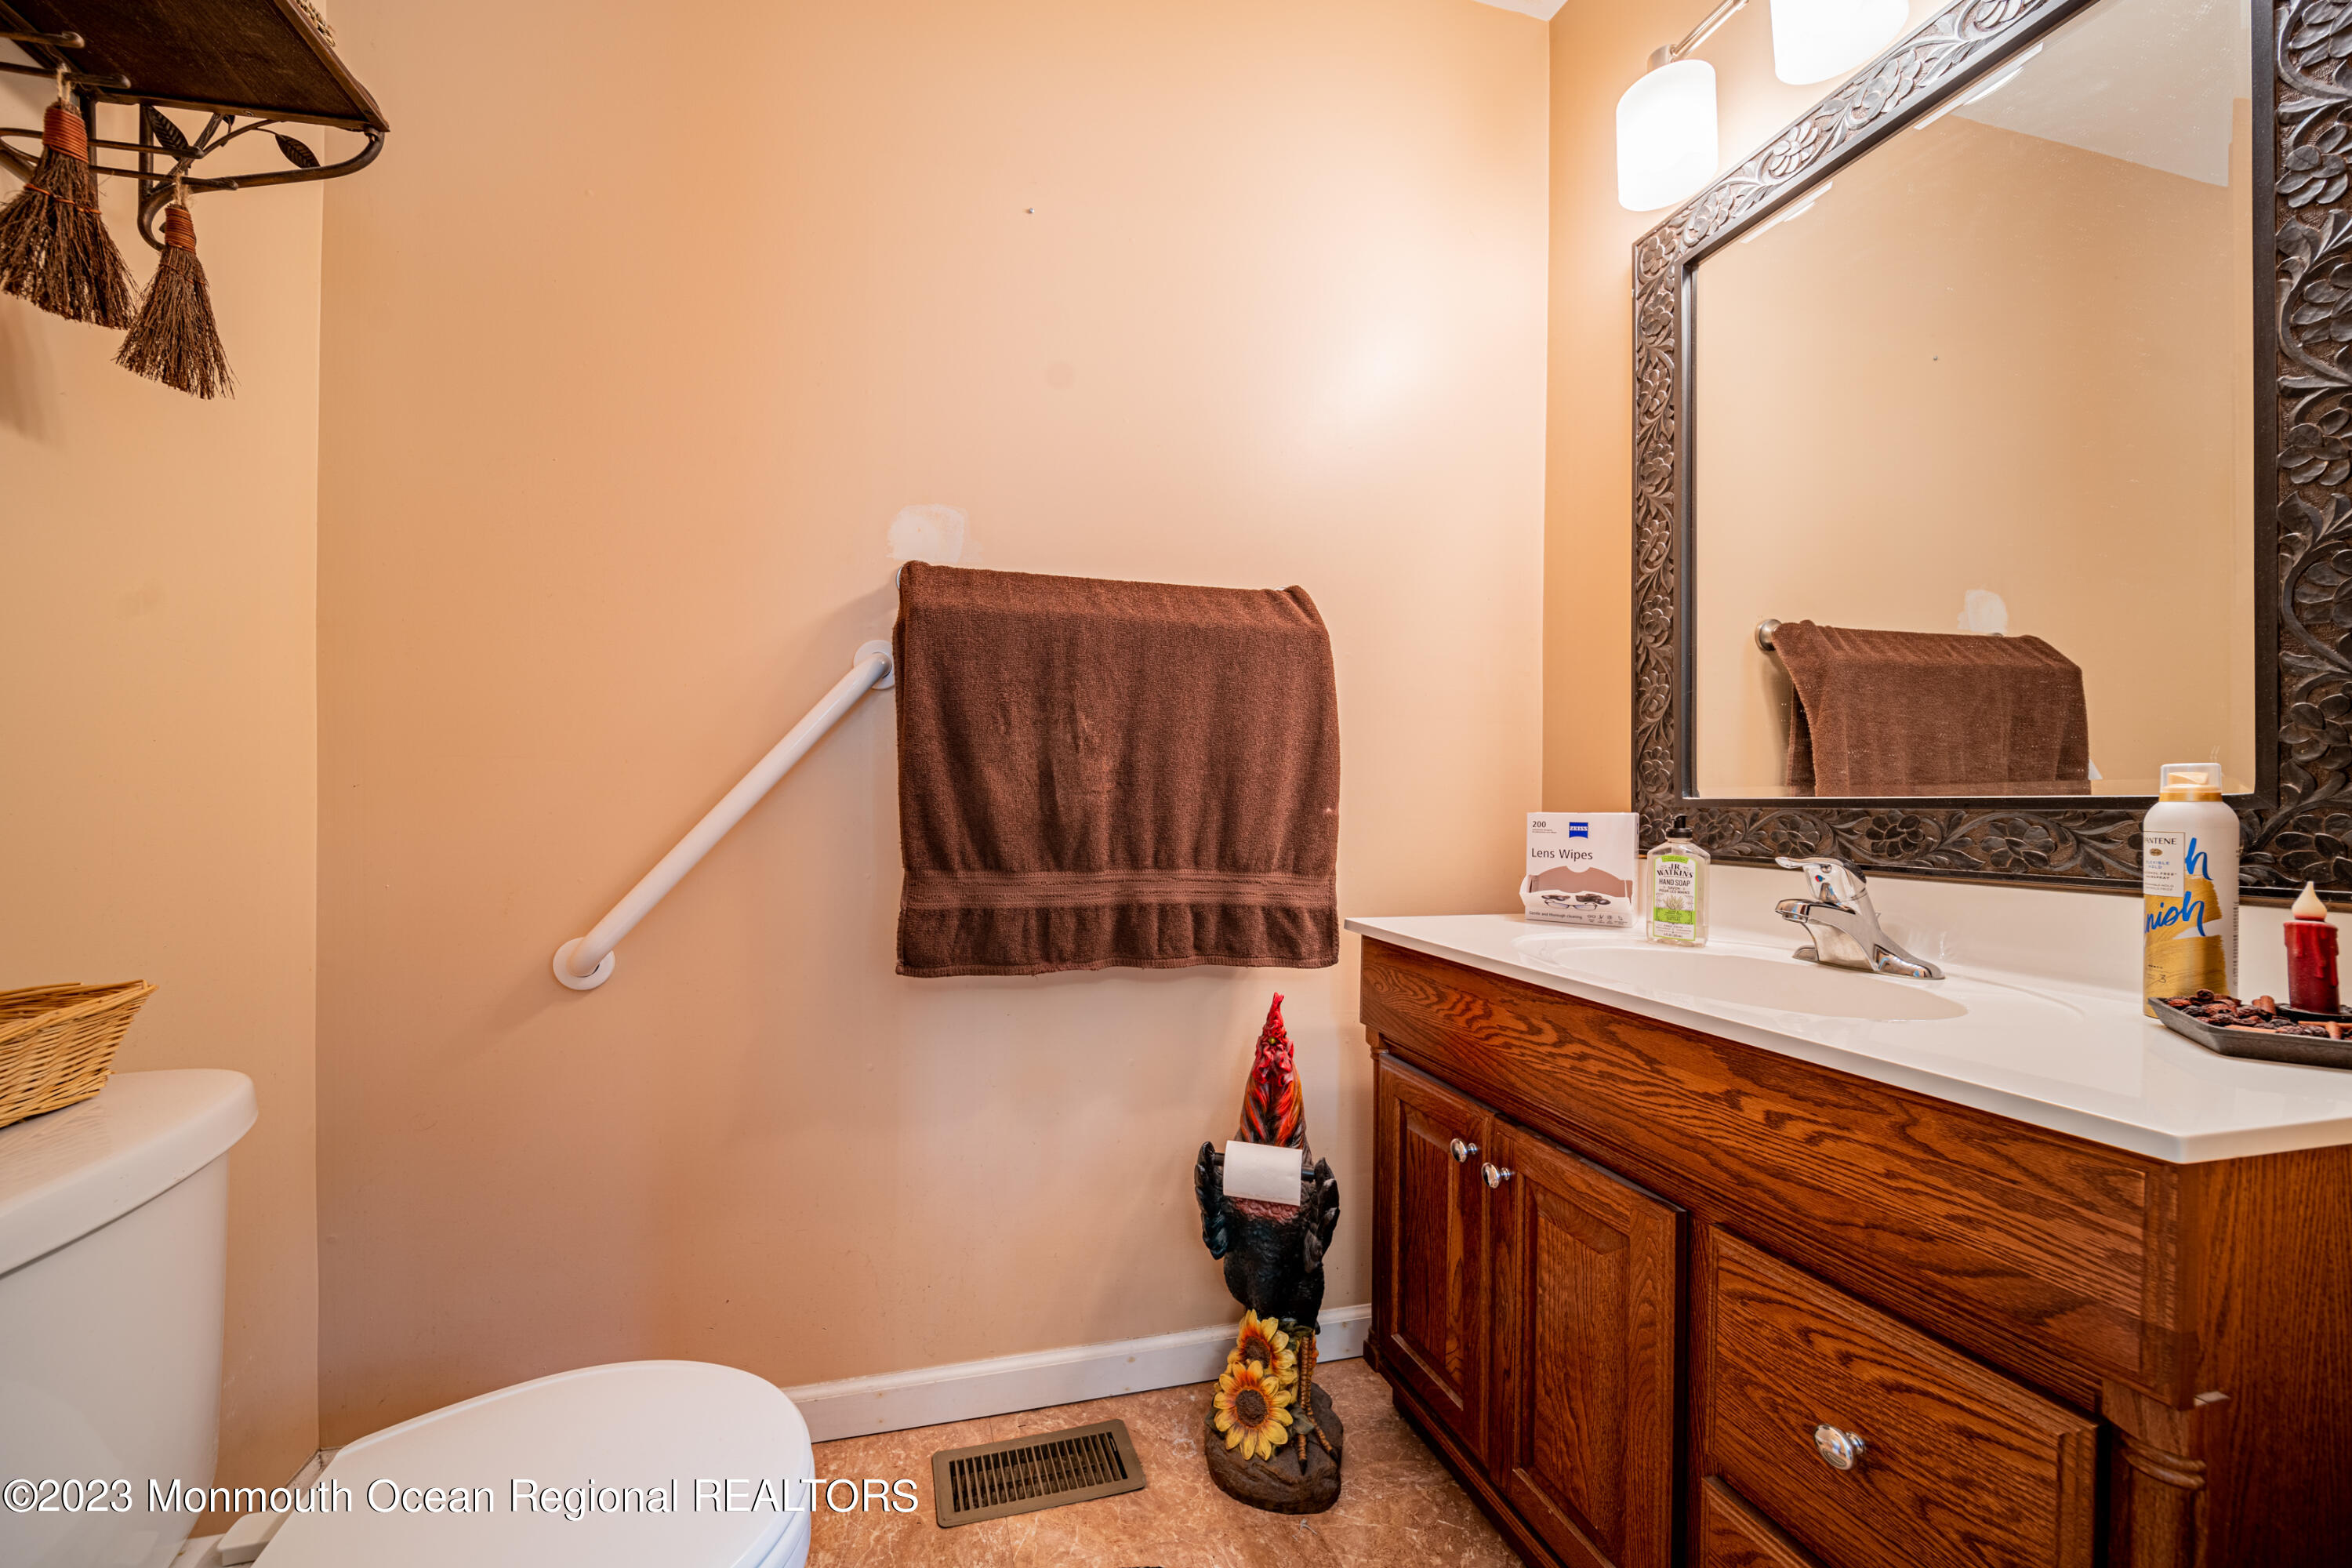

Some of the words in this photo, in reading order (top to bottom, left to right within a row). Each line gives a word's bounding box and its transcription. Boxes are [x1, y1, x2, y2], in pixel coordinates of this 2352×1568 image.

[2144, 837, 2177, 845] ANTENE
[1531, 848, 1555, 858] Lens
[1559, 849, 1593, 862] Wipes
[1657, 869, 1693, 878] WATKINS
[2145, 891, 2206, 937] nish
